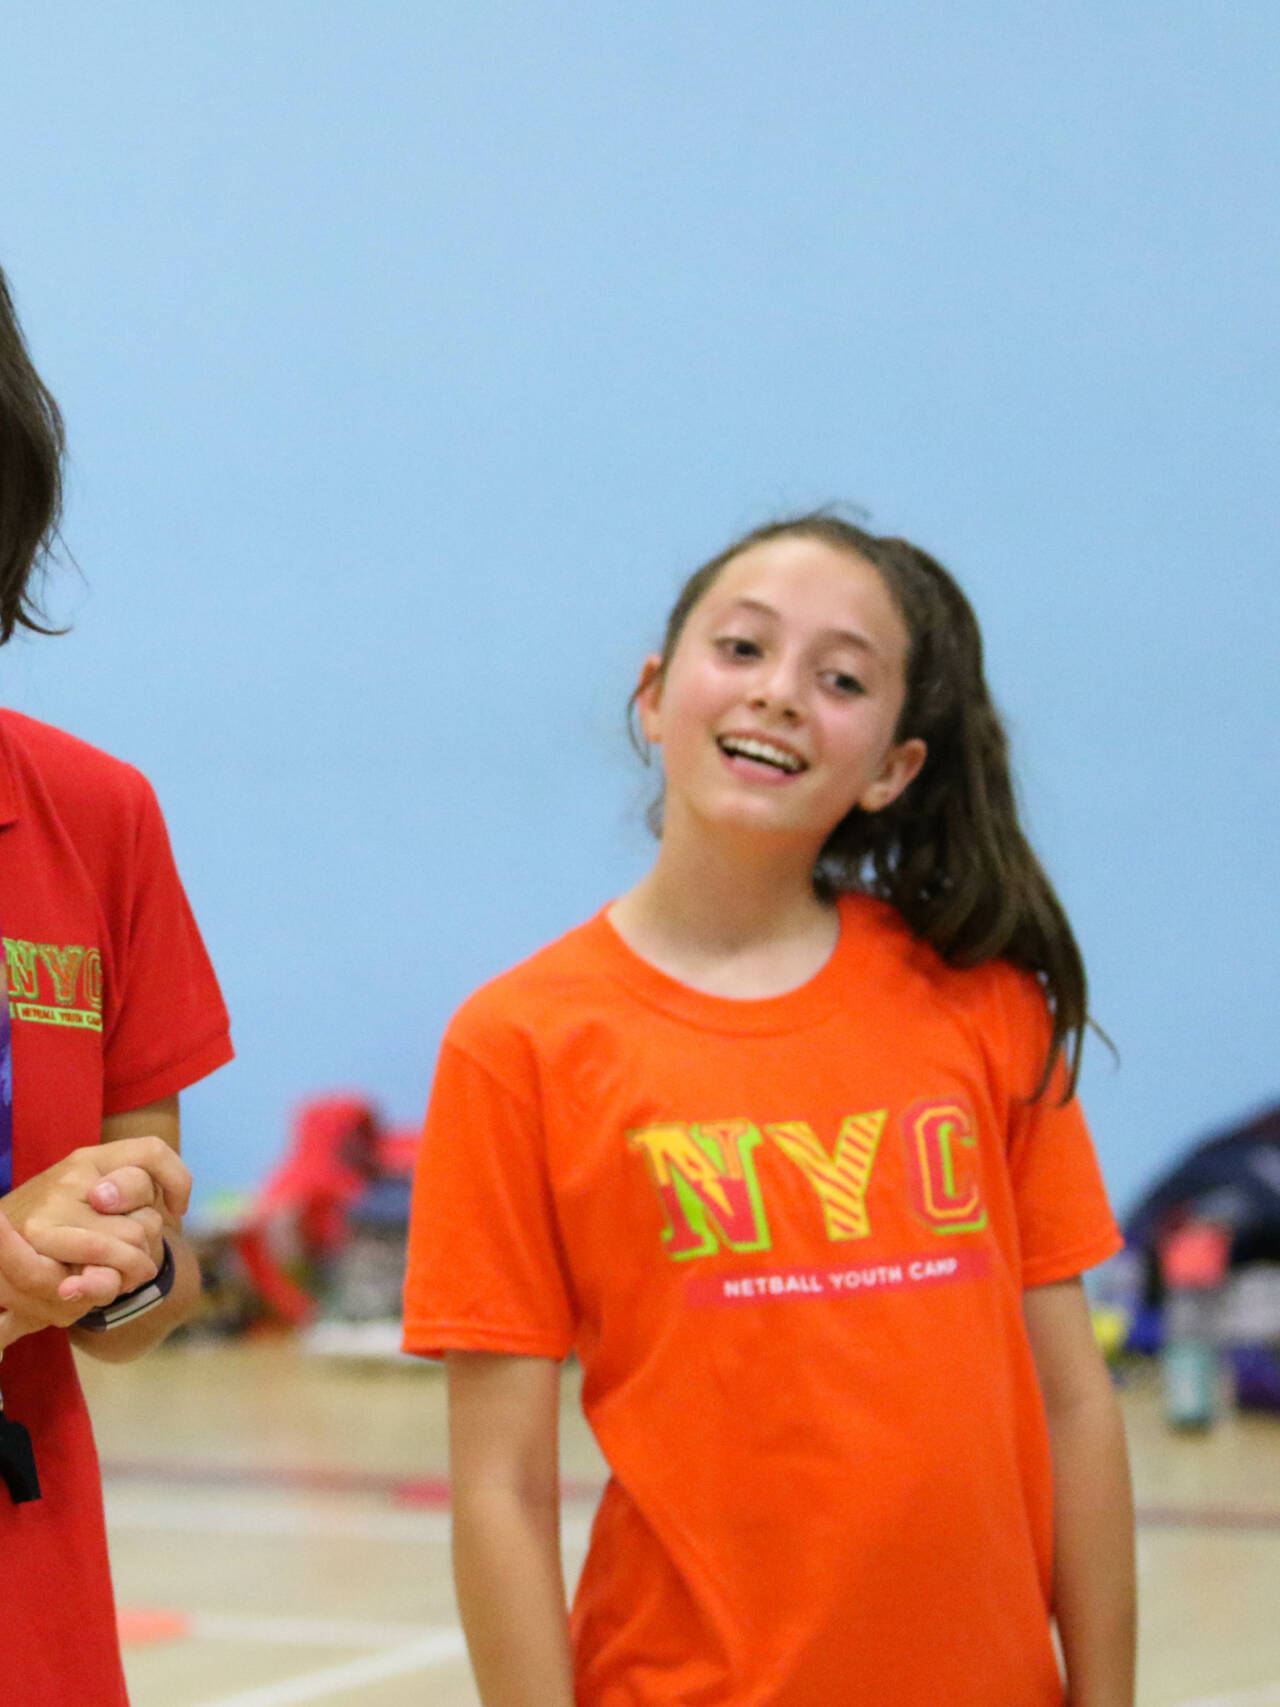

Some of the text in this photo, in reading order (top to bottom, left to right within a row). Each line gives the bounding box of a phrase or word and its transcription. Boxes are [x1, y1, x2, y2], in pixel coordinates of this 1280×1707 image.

[2, 937, 103, 1010] NYC
[625, 1097, 988, 1262] NYC
[723, 1257, 958, 1297] NETBALL YOUTH CAMP
